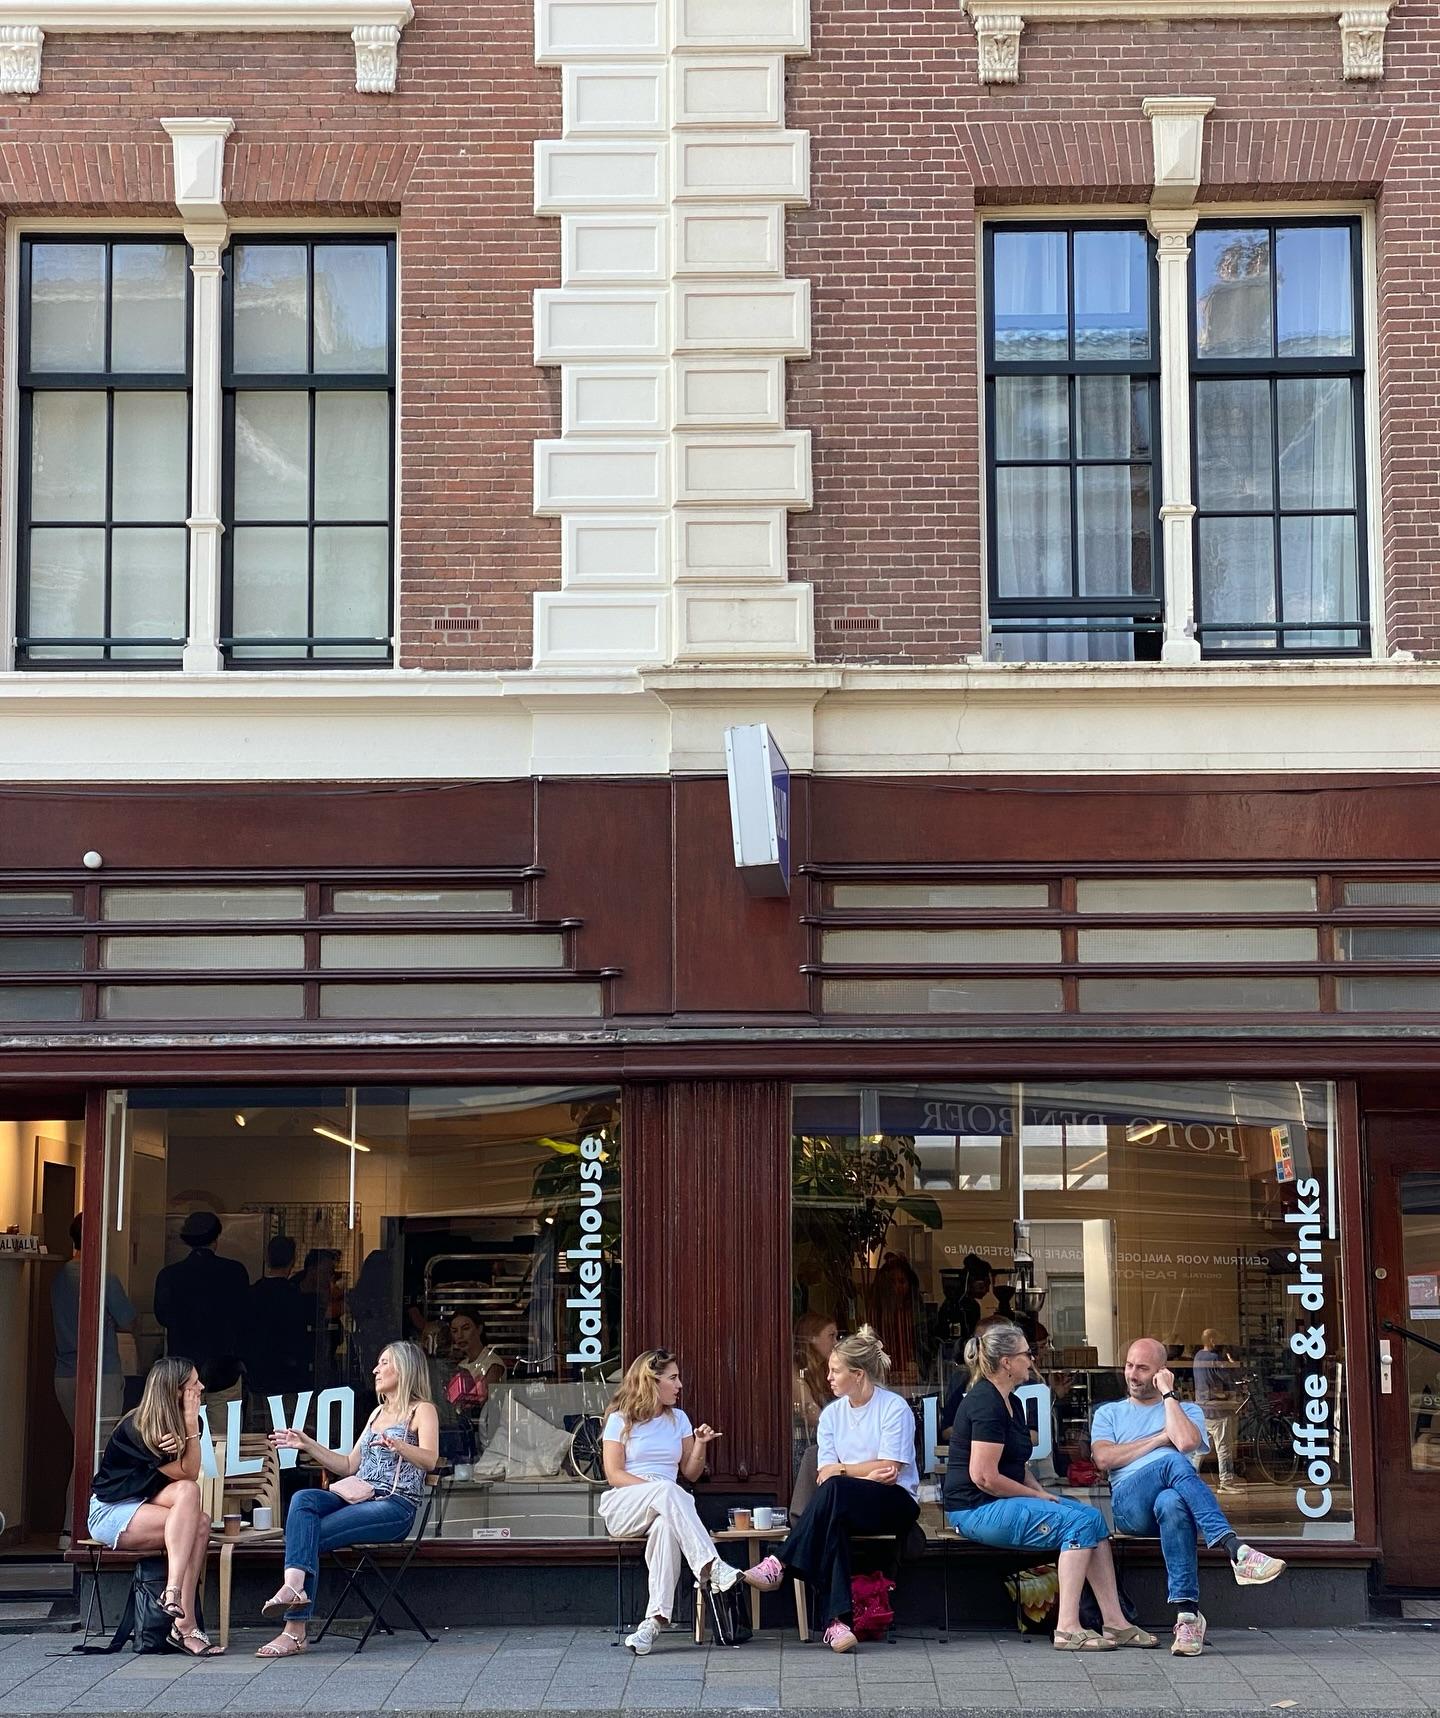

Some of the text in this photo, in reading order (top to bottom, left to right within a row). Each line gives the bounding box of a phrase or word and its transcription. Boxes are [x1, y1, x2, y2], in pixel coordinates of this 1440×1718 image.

[565, 1136, 603, 1363] bakehouse
[1284, 1176, 1334, 1519] Coffee & drinks
